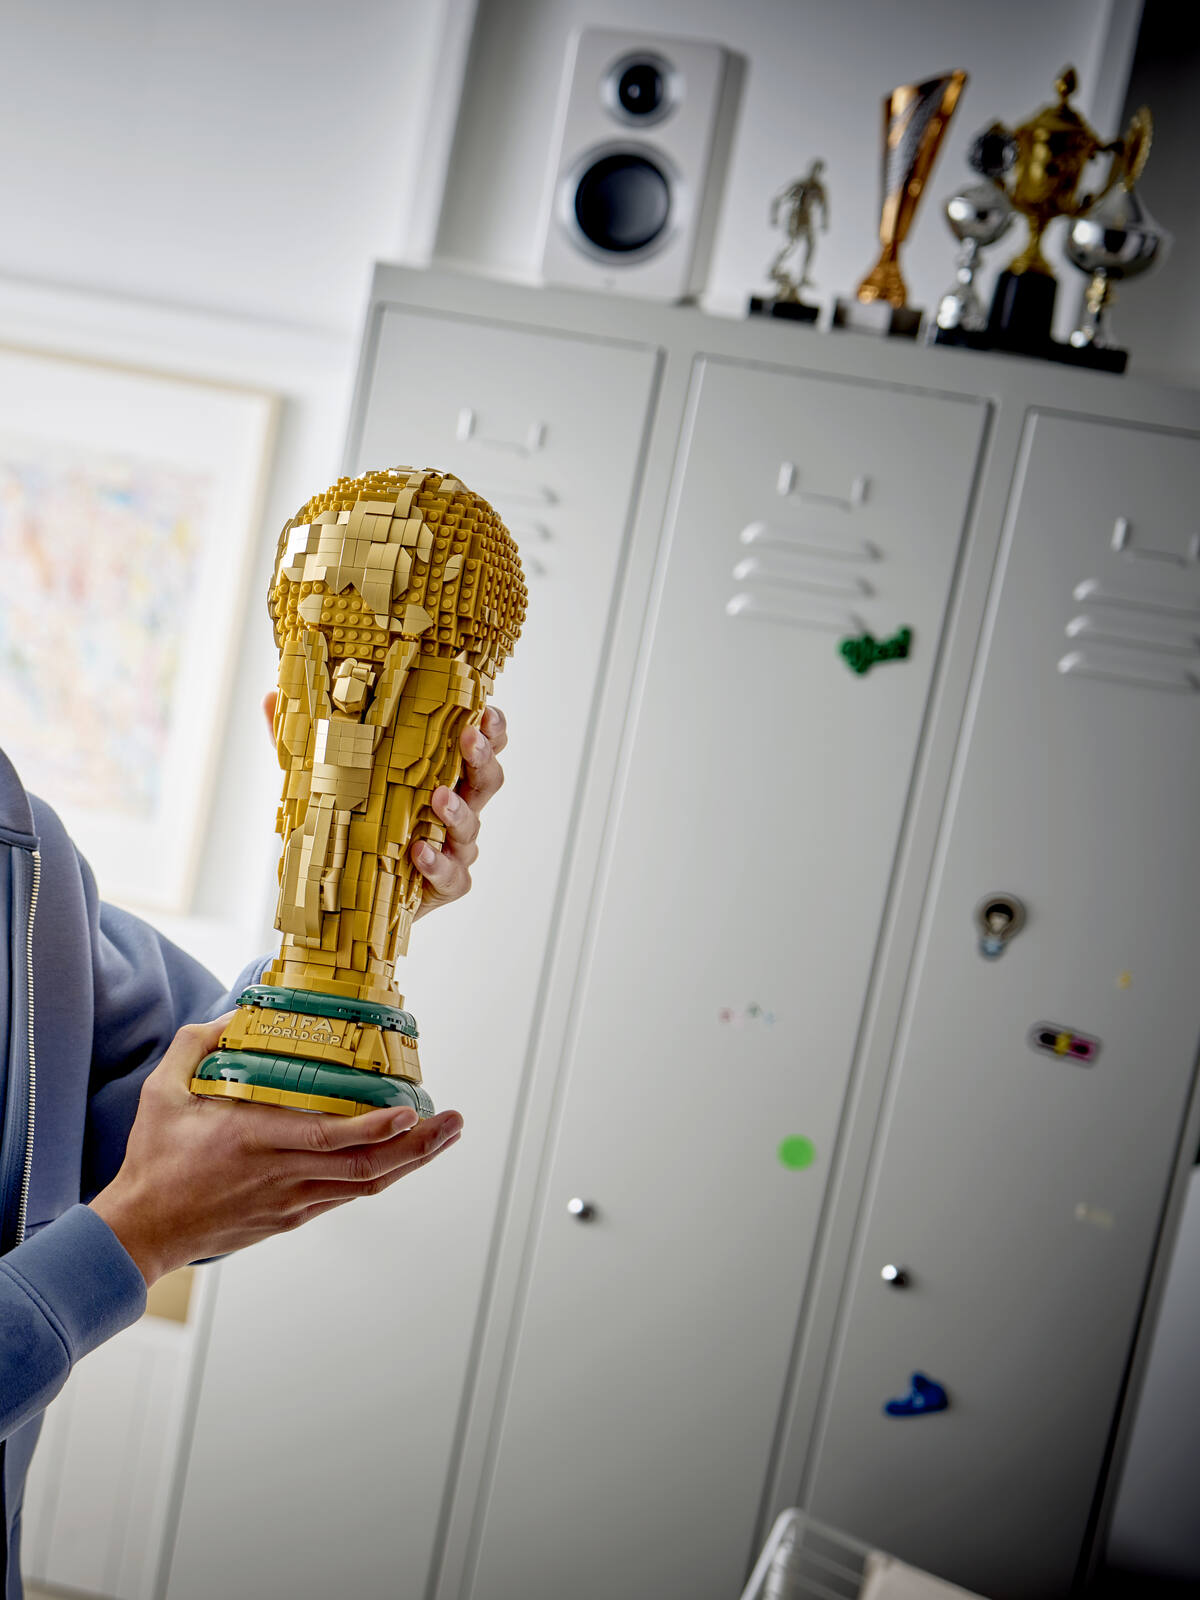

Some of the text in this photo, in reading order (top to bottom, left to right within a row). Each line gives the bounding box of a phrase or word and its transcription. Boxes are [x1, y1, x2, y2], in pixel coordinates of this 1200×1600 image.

[272, 1012, 334, 1034] FIFA
[260, 1024, 342, 1045] WORLD CUP
